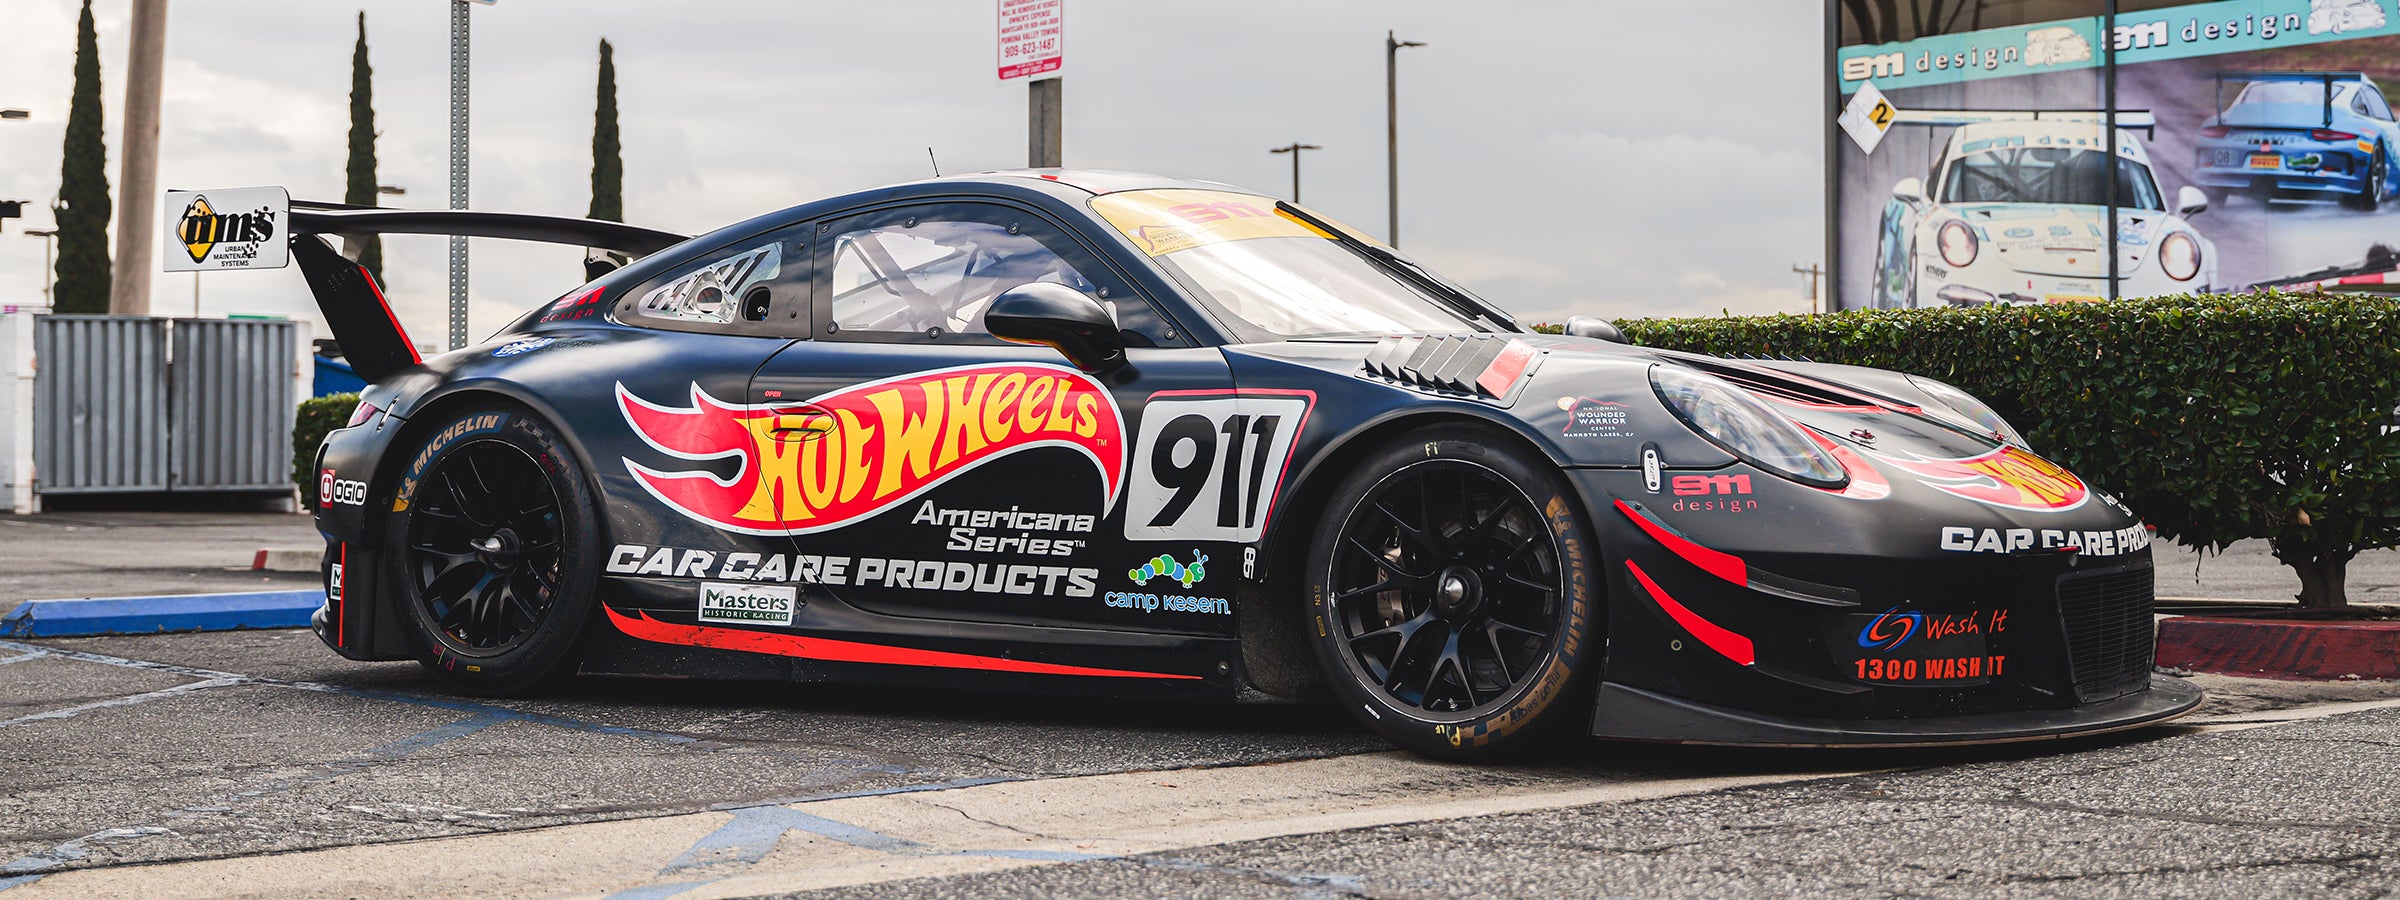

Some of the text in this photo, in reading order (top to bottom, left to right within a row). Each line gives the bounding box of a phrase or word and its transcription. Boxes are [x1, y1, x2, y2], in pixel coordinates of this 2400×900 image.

[2181, 13, 2300, 40] design
[1005, 38, 1054, 57] 909-623-1487
[1843, 45, 2018, 81] 911 design
[1875, 103, 1888, 124] 2
[1168, 201, 1273, 224] 911
[213, 252, 257, 260] MAINTENANCE
[221, 259, 249, 267] SYSTEMS
[540, 308, 595, 323] design
[764, 390, 782, 398] OPEN
[413, 415, 499, 476] MICHELIN
[1147, 413, 1282, 529] 911
[333, 479, 367, 506] OGIO
[1672, 474, 1752, 496] 911
[911, 499, 1096, 533] Americana
[1672, 499, 1758, 513] design
[1940, 526, 2035, 554] CAR
[2041, 529, 2116, 557] CARE
[606, 544, 1100, 599] CAR CARE PRODUCTS
[705, 588, 789, 612] Masters
[1104, 590, 1159, 614] camp
[1564, 538, 1587, 658] MICHELIN
[704, 609, 788, 621] HISTORIC RACING
[1926, 609, 2008, 640] Wash It
[1854, 655, 2006, 681] 1300 WASH IT
